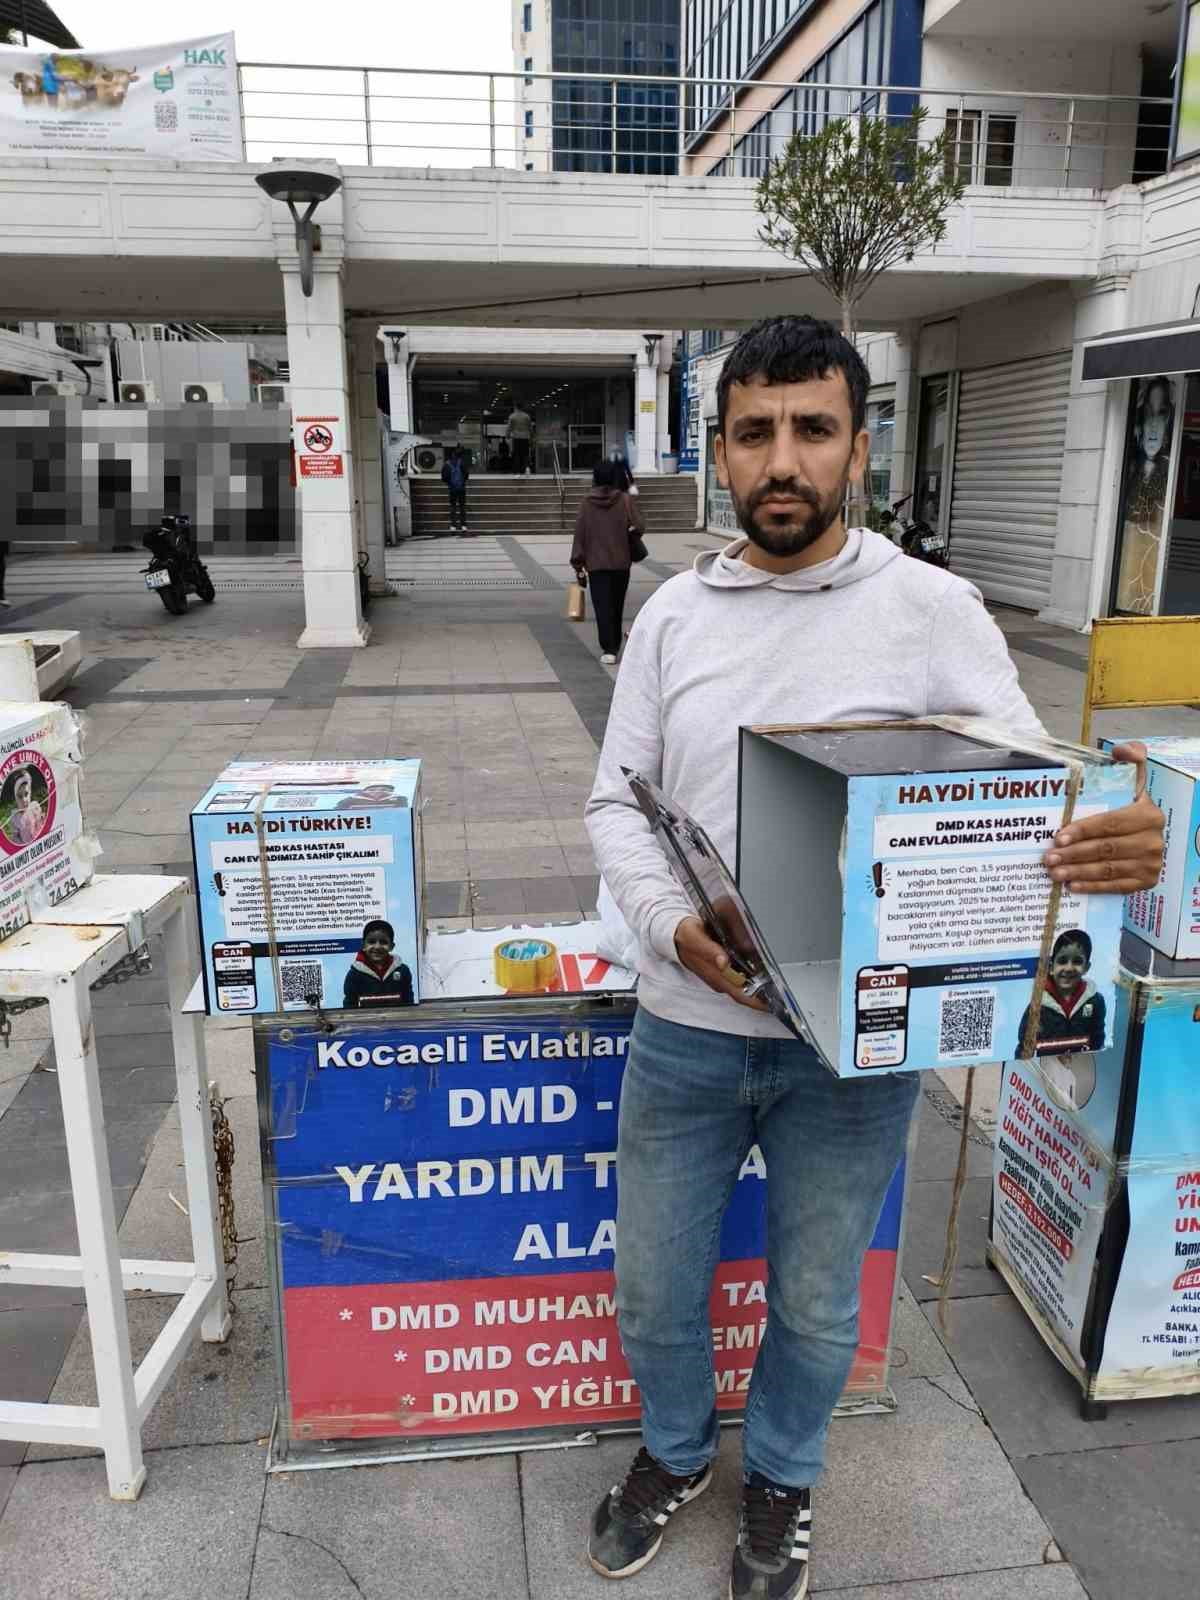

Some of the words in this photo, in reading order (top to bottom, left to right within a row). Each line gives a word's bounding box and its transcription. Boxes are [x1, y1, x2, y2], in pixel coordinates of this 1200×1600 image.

[184, 49, 225, 65] HAK
[899, 778, 975, 804] HAYDİ
[288, 814, 372, 833] TÜRKİYE!
[936, 821, 965, 832] DMD
[967, 819, 993, 830] KAS
[994, 816, 1047, 828] HASTASI
[282, 844, 303, 852] KAS
[304, 842, 345, 851] HASTASI
[889, 837, 917, 848] CAN
[919, 832, 994, 847] EVLADIMIZA
[995, 829, 1032, 842] SAHİP
[224, 855, 246, 864] CAN
[247, 852, 304, 863] EVADIMIZA
[305, 850, 335, 860] SAHİP
[336, 849, 380, 861] ÇIKALIM!
[222, 949, 243, 957] CAN
[870, 976, 897, 987] CAN
[317, 1035, 468, 1069] Kocaeli
[482, 1030, 632, 1063] Evlatlar
[448, 1084, 578, 1128] DMD
[1009, 1072, 1033, 1101] DMD
[1032, 1093, 1053, 1123] KAS
[1009, 1094, 1035, 1130] YİĞİT
[1003, 1114, 1034, 1153] UMUT
[334, 1153, 565, 1203] YARDIM
[1176, 1171, 1200, 1190] DM
[513, 1219, 617, 1262] ALA
[370, 1303, 460, 1331] DMD
[474, 1293, 618, 1327] MUHAM
[1165, 1321, 1198, 1333] BANKA
[1153, 1333, 1187, 1344] HESABI
[425, 1345, 513, 1374] DMD
[526, 1337, 608, 1367] CAN
[432, 1388, 520, 1418] DMD
[532, 1377, 638, 1410] YİĞİT
